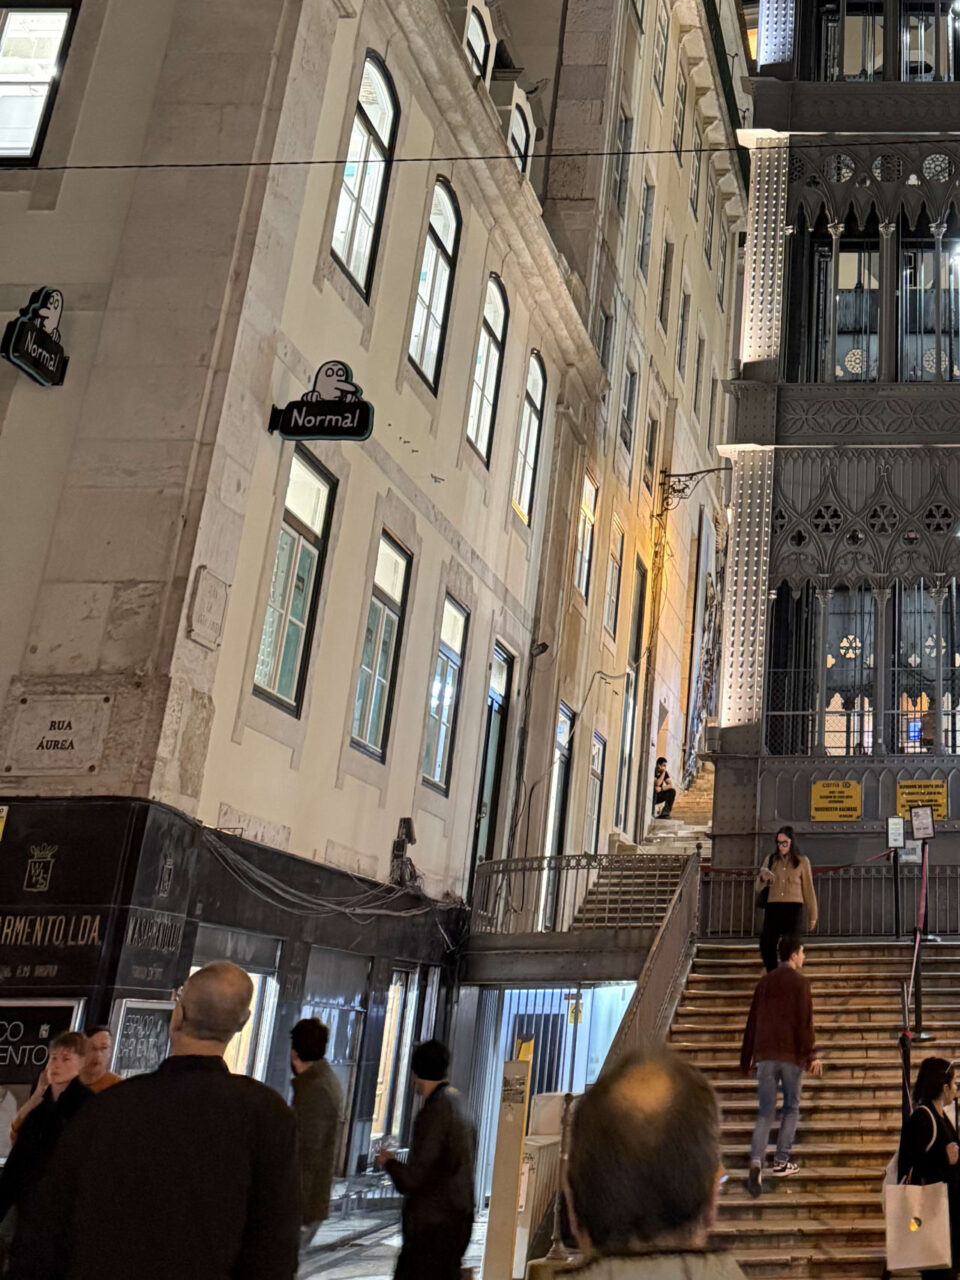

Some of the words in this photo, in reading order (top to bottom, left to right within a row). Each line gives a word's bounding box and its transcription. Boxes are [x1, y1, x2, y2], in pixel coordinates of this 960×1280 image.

[25, 331, 60, 372] Normal
[291, 407, 360, 428] Normal
[49, 720, 73, 731] RUA
[36, 736, 75, 750] ÁUREA
